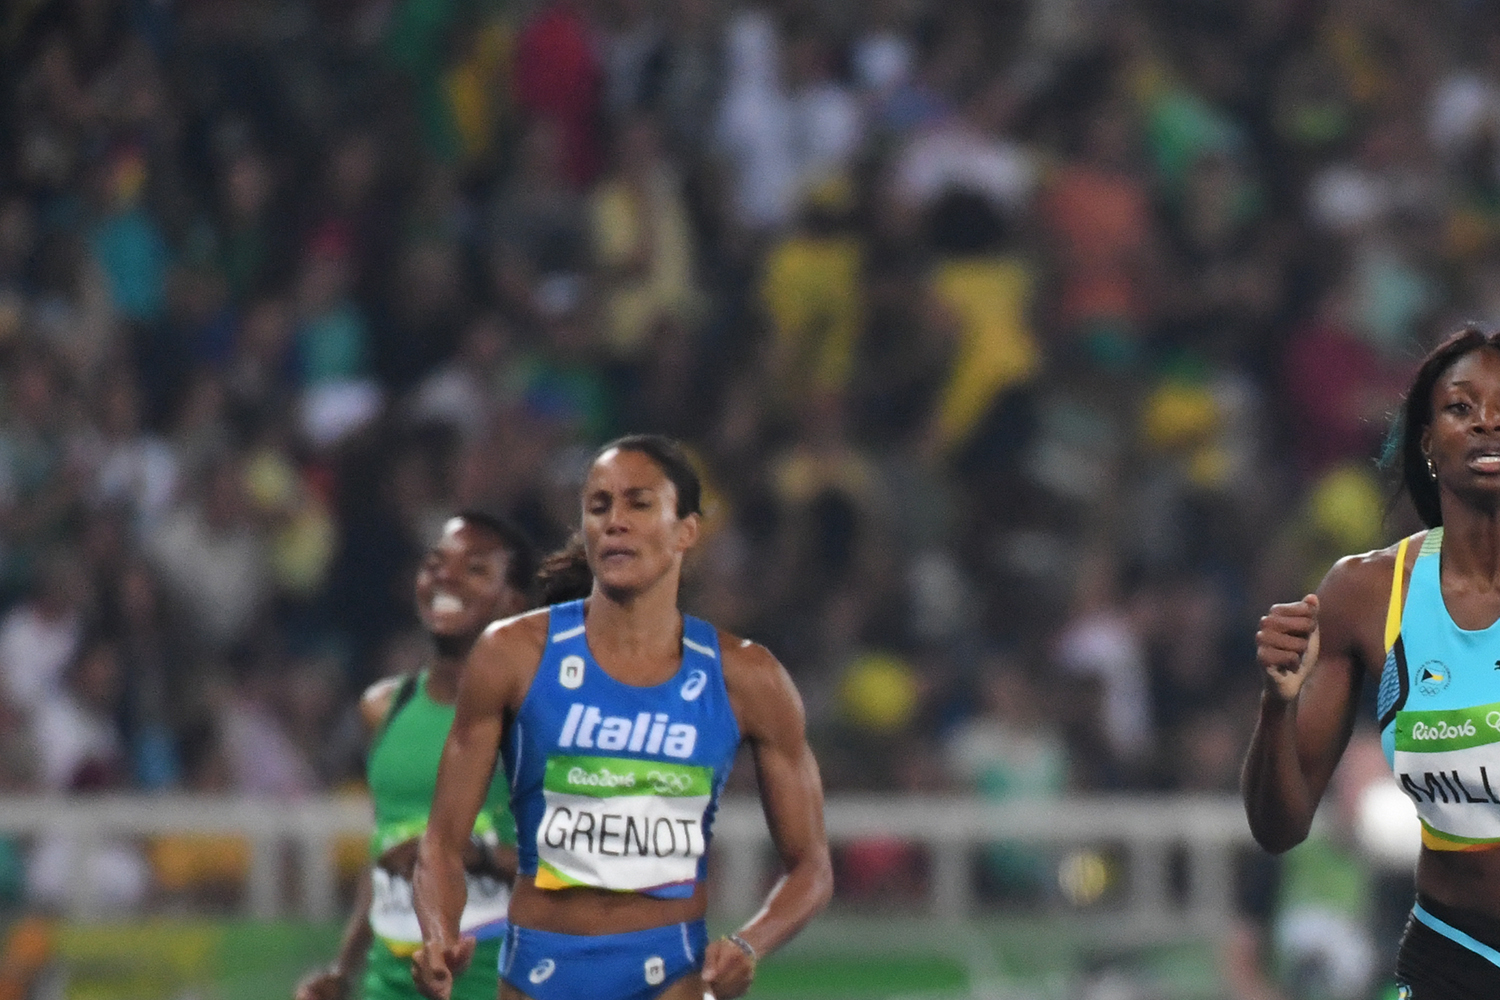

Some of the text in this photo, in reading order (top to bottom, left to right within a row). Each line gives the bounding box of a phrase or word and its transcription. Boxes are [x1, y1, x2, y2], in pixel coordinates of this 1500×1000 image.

[558, 702, 698, 759] Italia
[1412, 719, 1477, 741] Rio2016
[544, 806, 697, 858] GRENOT
